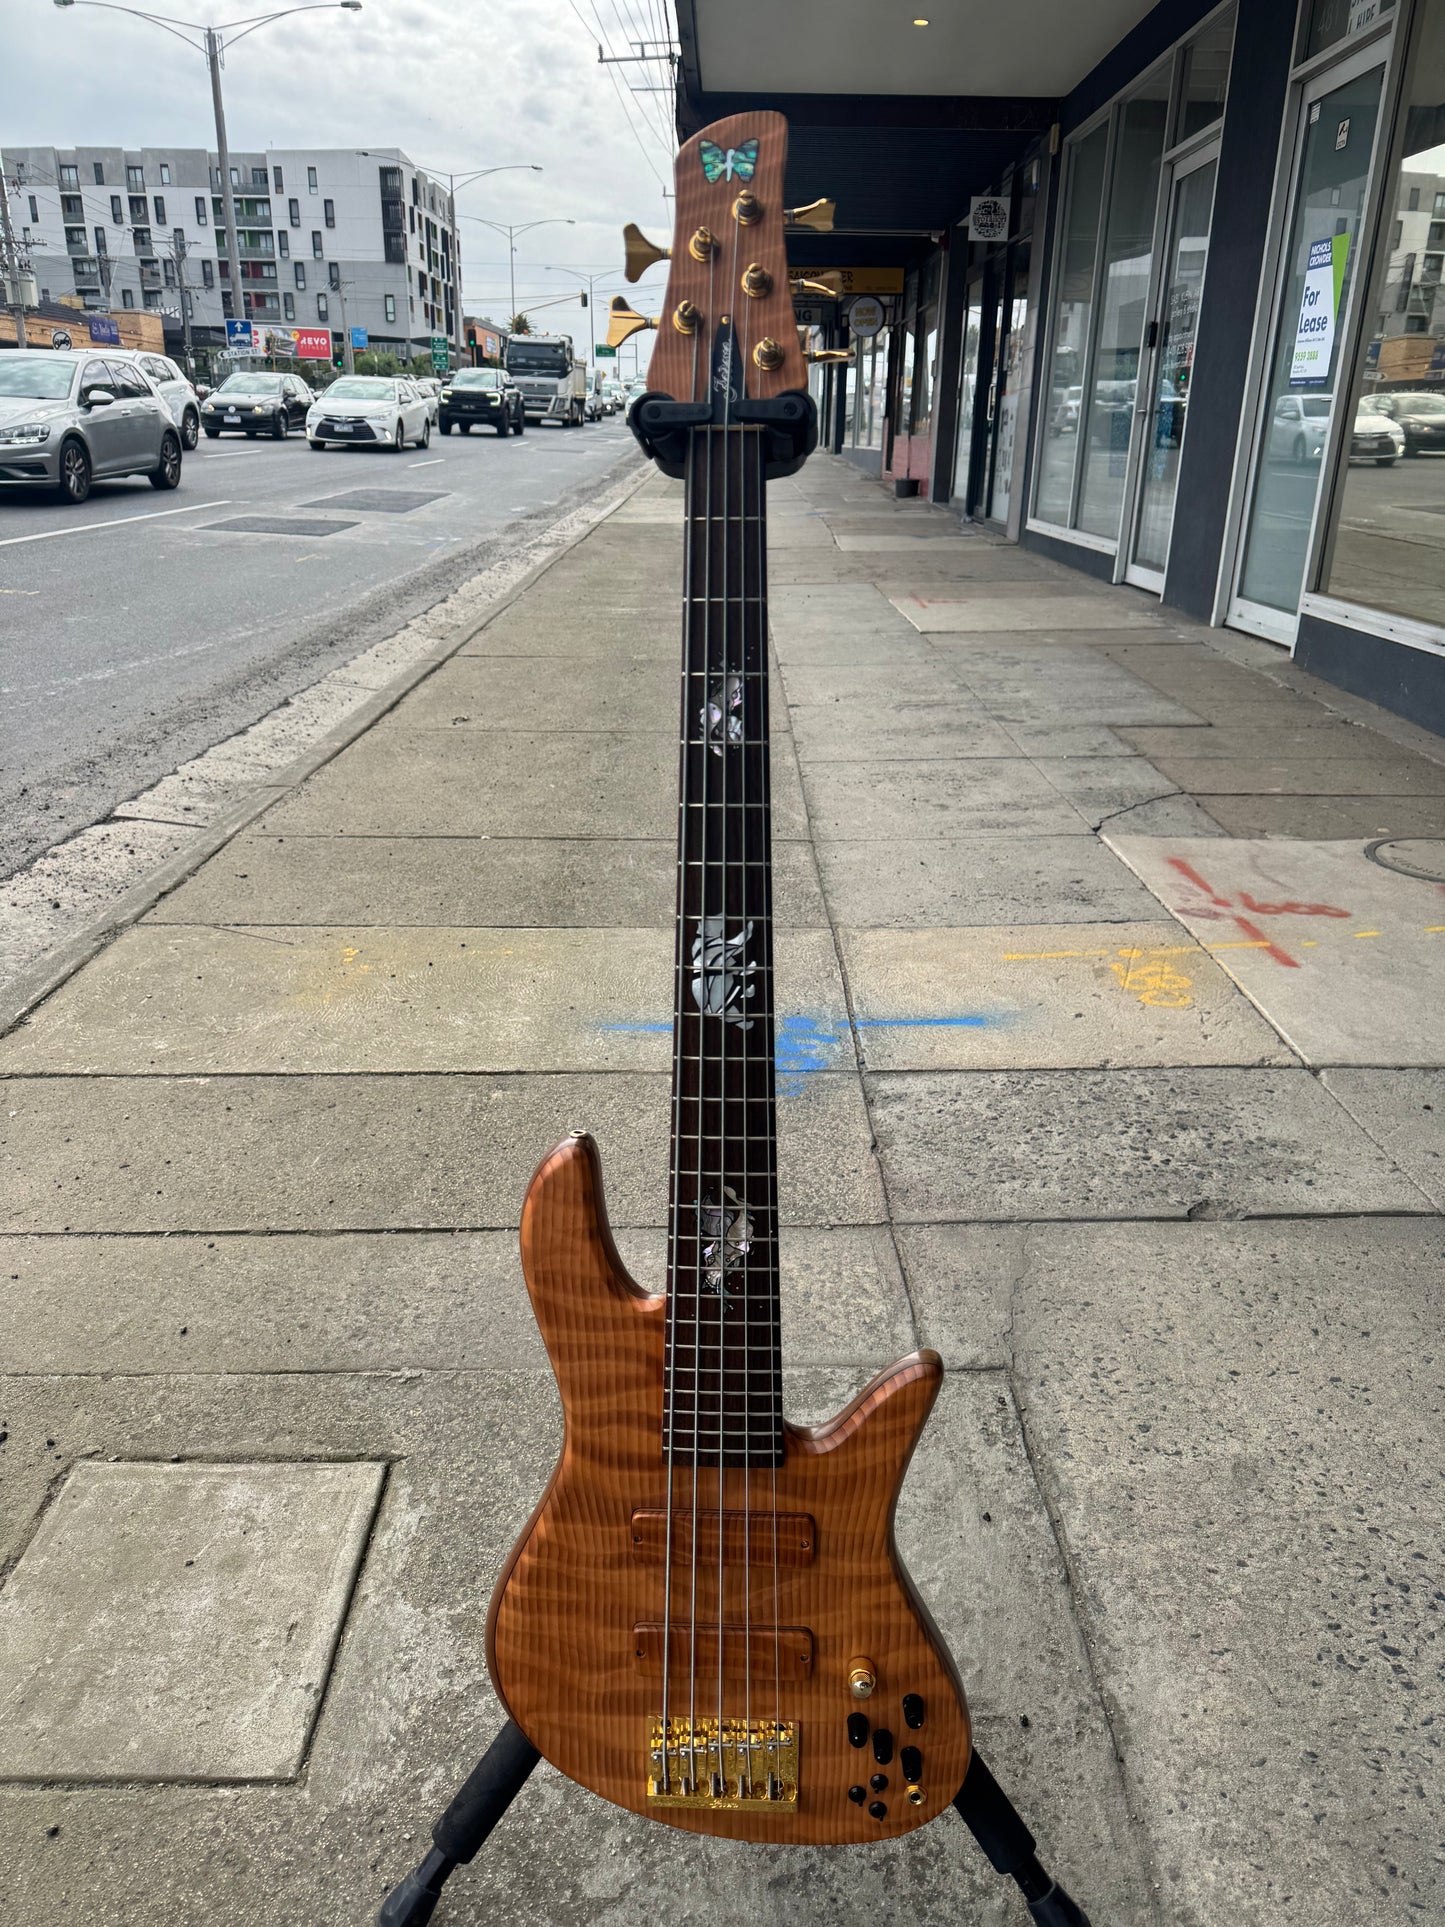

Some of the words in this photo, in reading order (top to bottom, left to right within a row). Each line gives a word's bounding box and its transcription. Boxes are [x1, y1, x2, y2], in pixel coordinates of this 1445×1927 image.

[1311, 240, 1332, 256] NICHOLS
[1309, 252, 1332, 267] CROWDER
[1303, 286, 1320, 307] For
[1299, 313, 1328, 334] Lease
[227, 349, 250, 358] STATION
